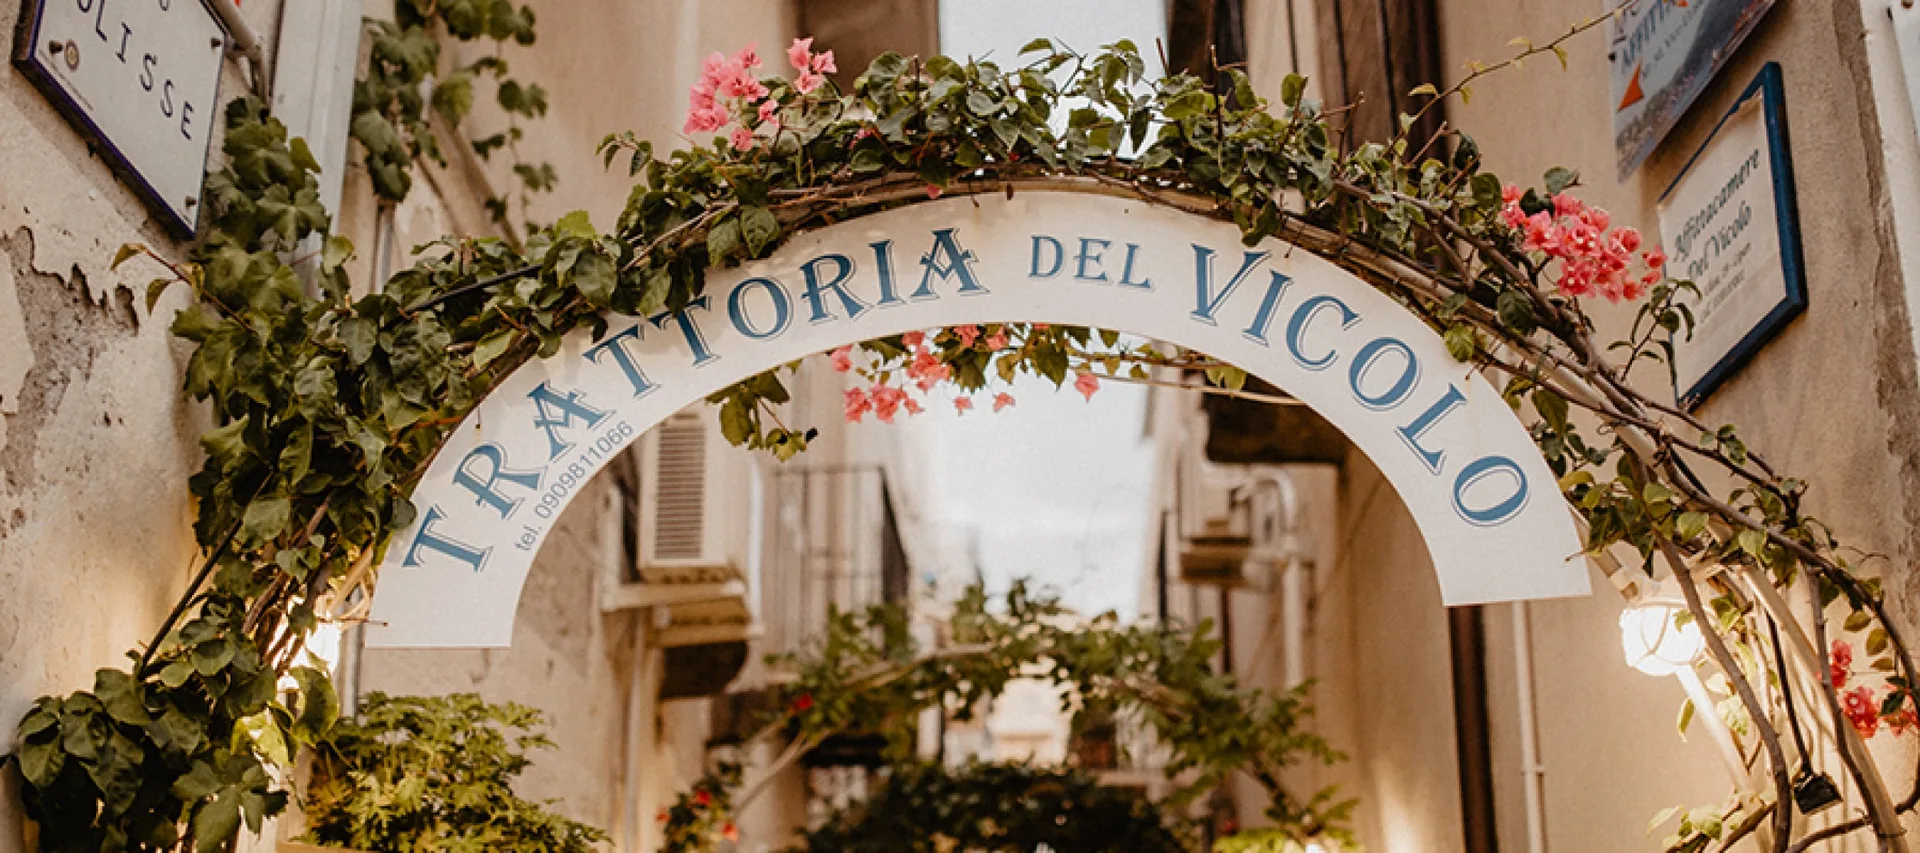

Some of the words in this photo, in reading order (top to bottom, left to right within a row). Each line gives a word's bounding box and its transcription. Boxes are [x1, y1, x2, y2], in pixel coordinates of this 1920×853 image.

[402, 227, 988, 573] TRATTORIA
[1028, 234, 1153, 290] DEL
[1189, 243, 1530, 527] VICOLO
[514, 524, 543, 551] tel.
[535, 420, 634, 519] 0909811066
